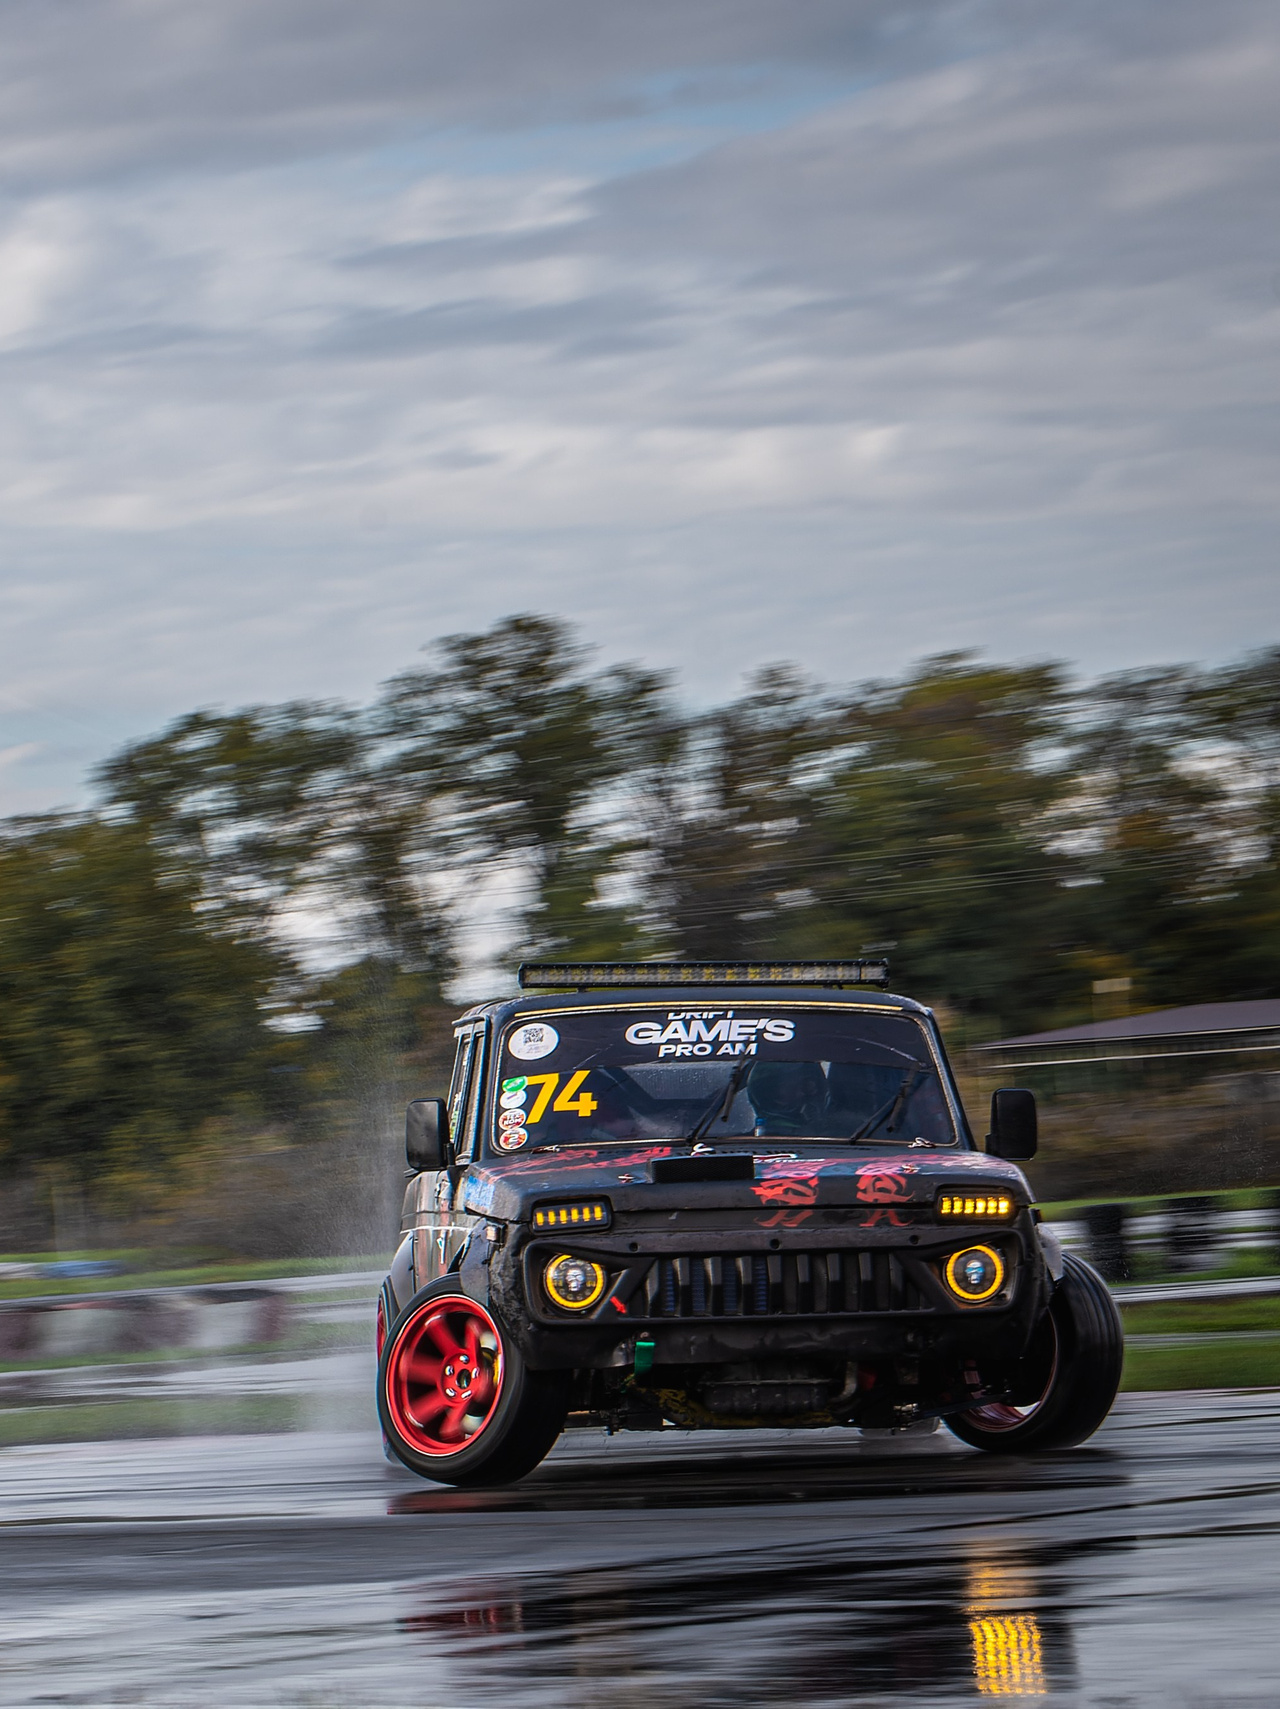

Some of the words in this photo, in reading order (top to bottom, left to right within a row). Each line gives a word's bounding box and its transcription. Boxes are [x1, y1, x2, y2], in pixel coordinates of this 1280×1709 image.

[625, 1018, 796, 1045] GAME'S
[658, 1043, 713, 1058] PRO
[716, 1042, 758, 1056] AM
[525, 1069, 598, 1125] 74
